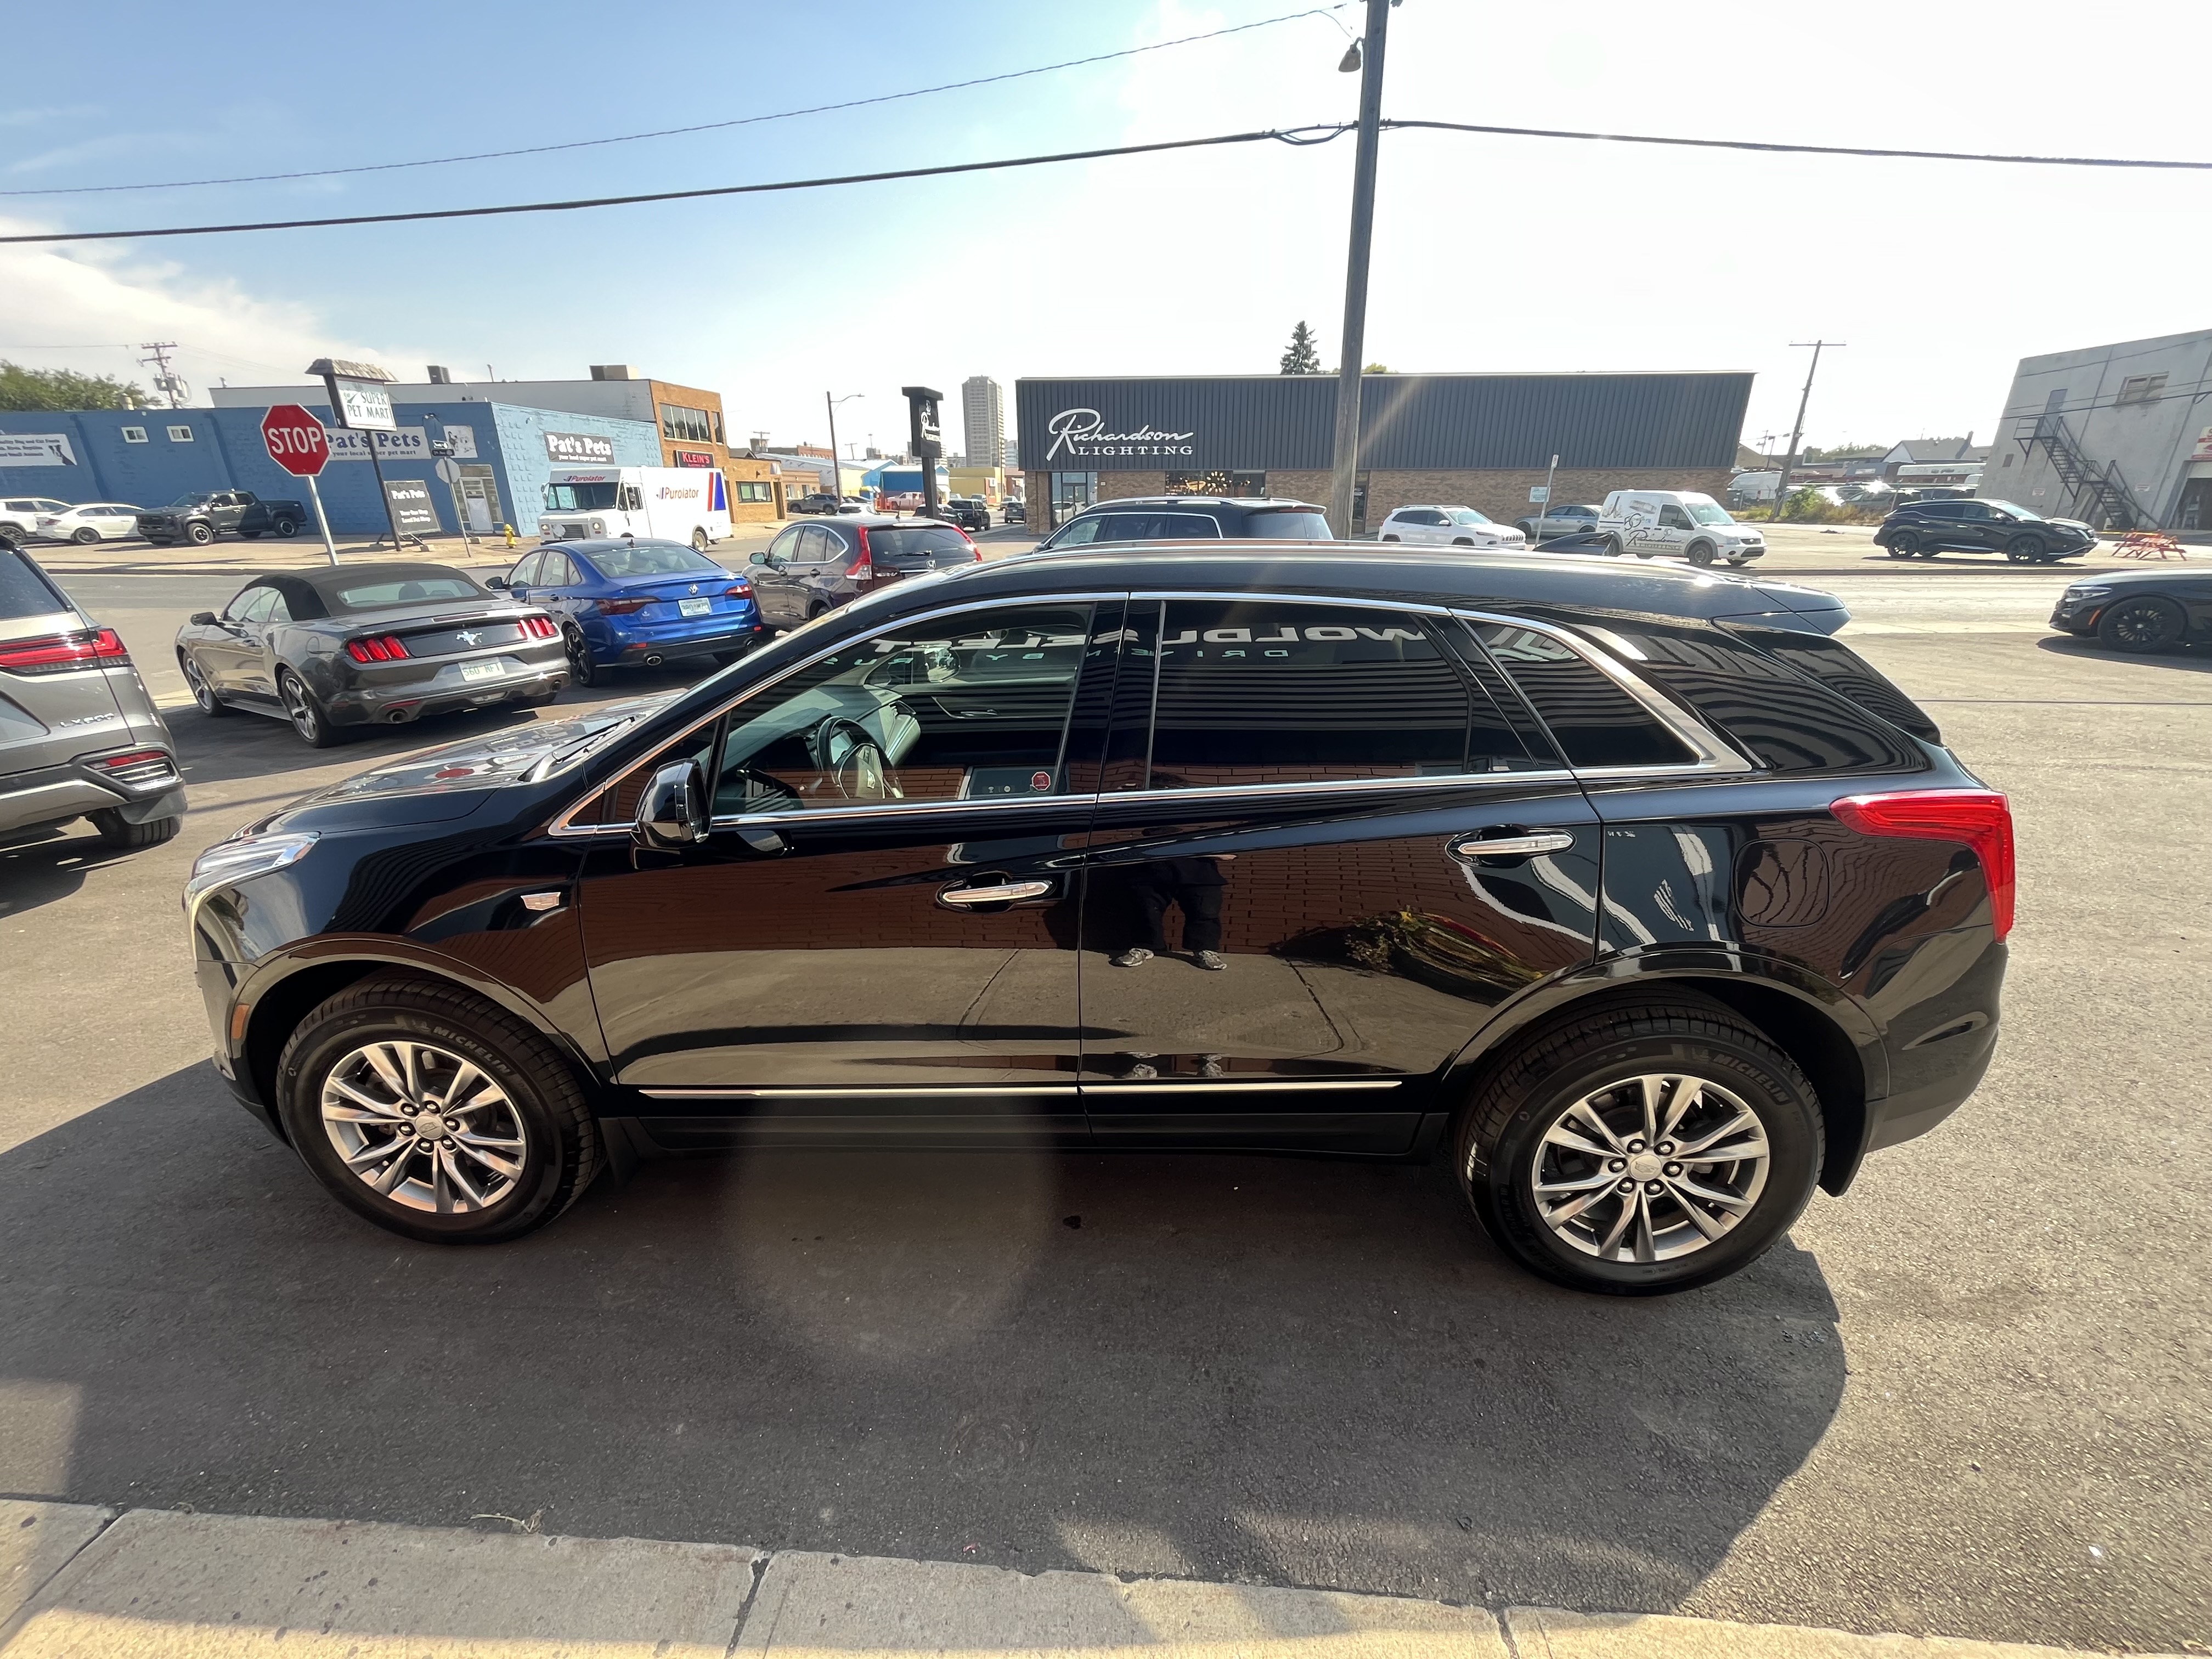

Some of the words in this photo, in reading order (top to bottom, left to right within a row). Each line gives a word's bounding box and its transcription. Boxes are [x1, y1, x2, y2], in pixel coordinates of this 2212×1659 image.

[360, 391, 387, 405] SUPER
[347, 404, 362, 417] PET
[366, 406, 389, 419] MART
[267, 427, 321, 454] STOP
[375, 432, 421, 447] Pets
[1046, 408, 1194, 461] Richardson
[546, 435, 583, 454] Pat's
[582, 437, 612, 455] Pets
[1078, 445, 1194, 456] LIGHTING
[682, 452, 710, 464] KLEIN'S
[665, 487, 699, 499] Purolator
[433, 1026, 511, 1074] MICHELIN
[1713, 1053, 1790, 1103] MICHELIN
